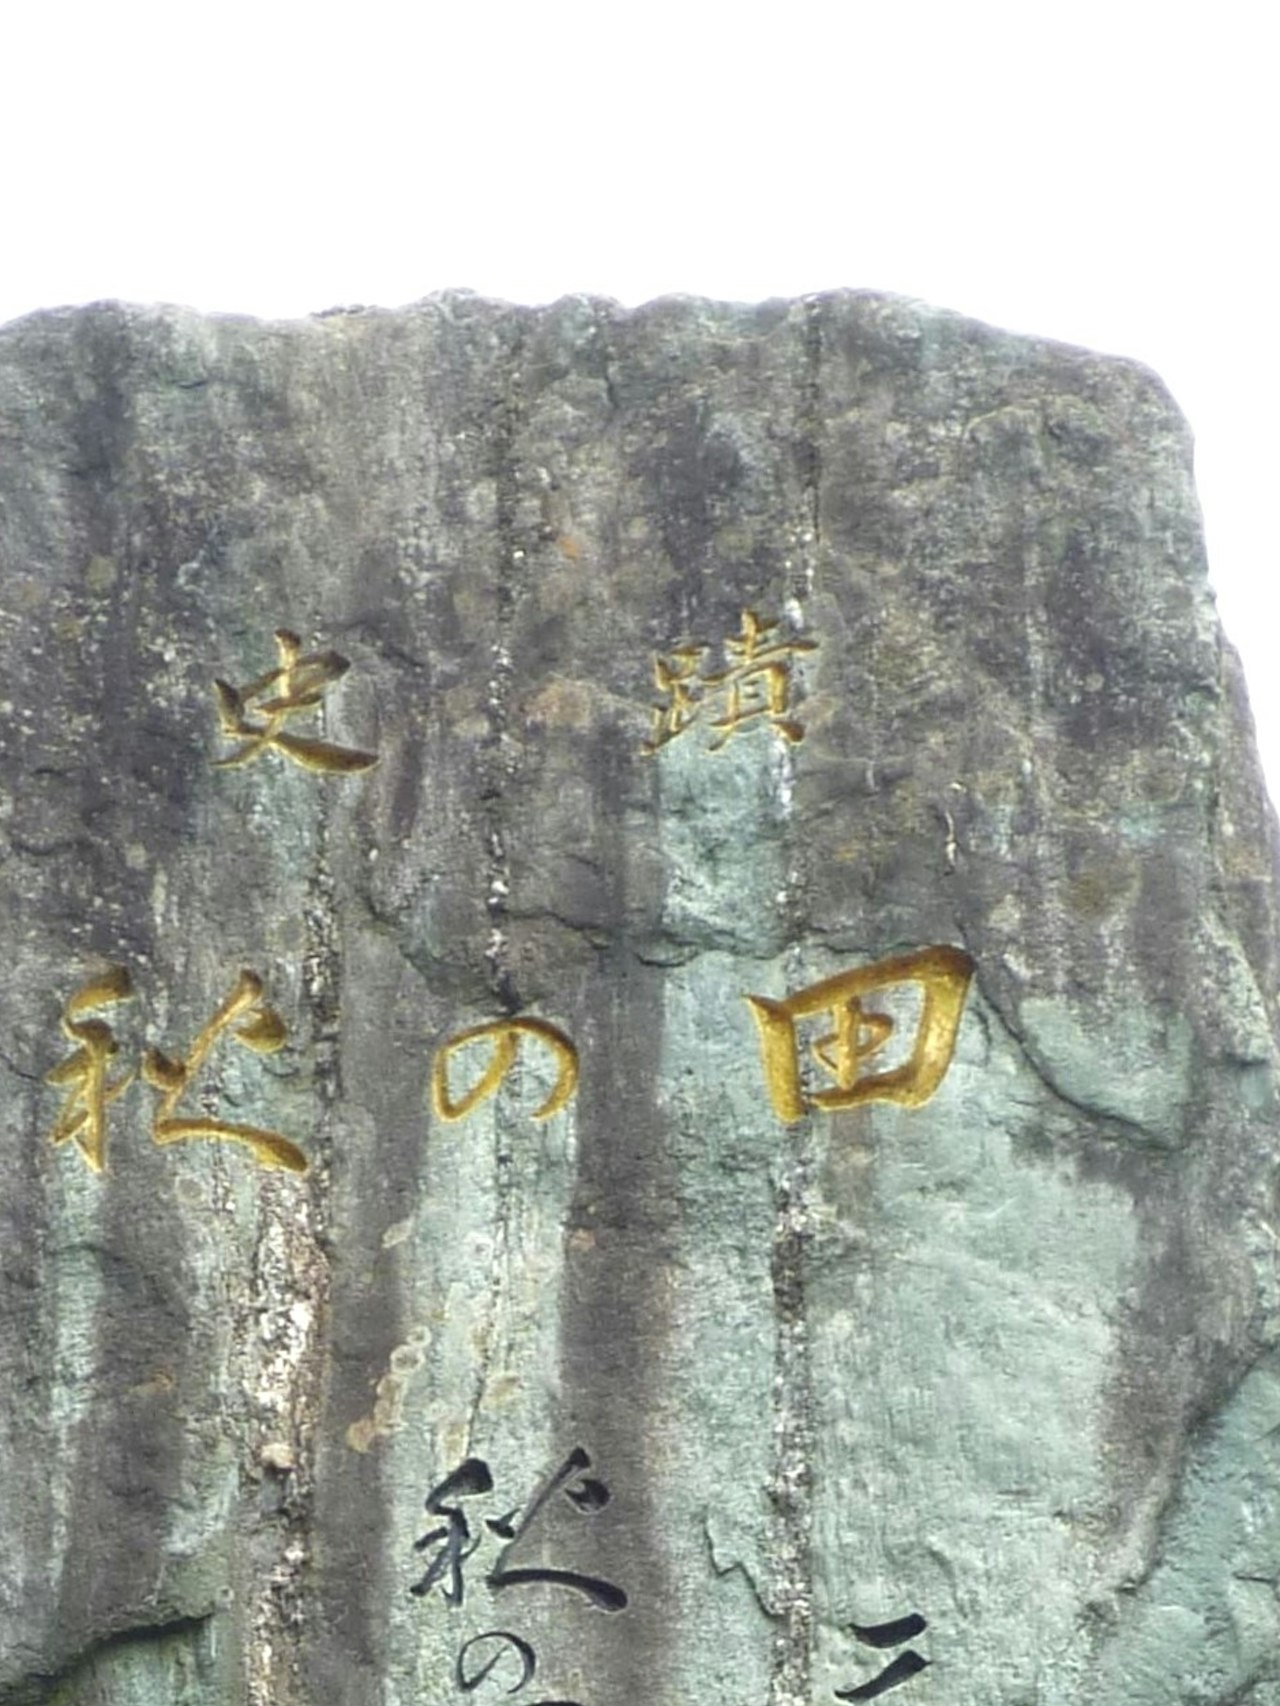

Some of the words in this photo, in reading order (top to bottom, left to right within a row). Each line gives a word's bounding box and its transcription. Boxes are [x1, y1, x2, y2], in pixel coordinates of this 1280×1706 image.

[213, 608, 818, 776] 史蹟
[43, 944, 975, 1174] 秋の田
